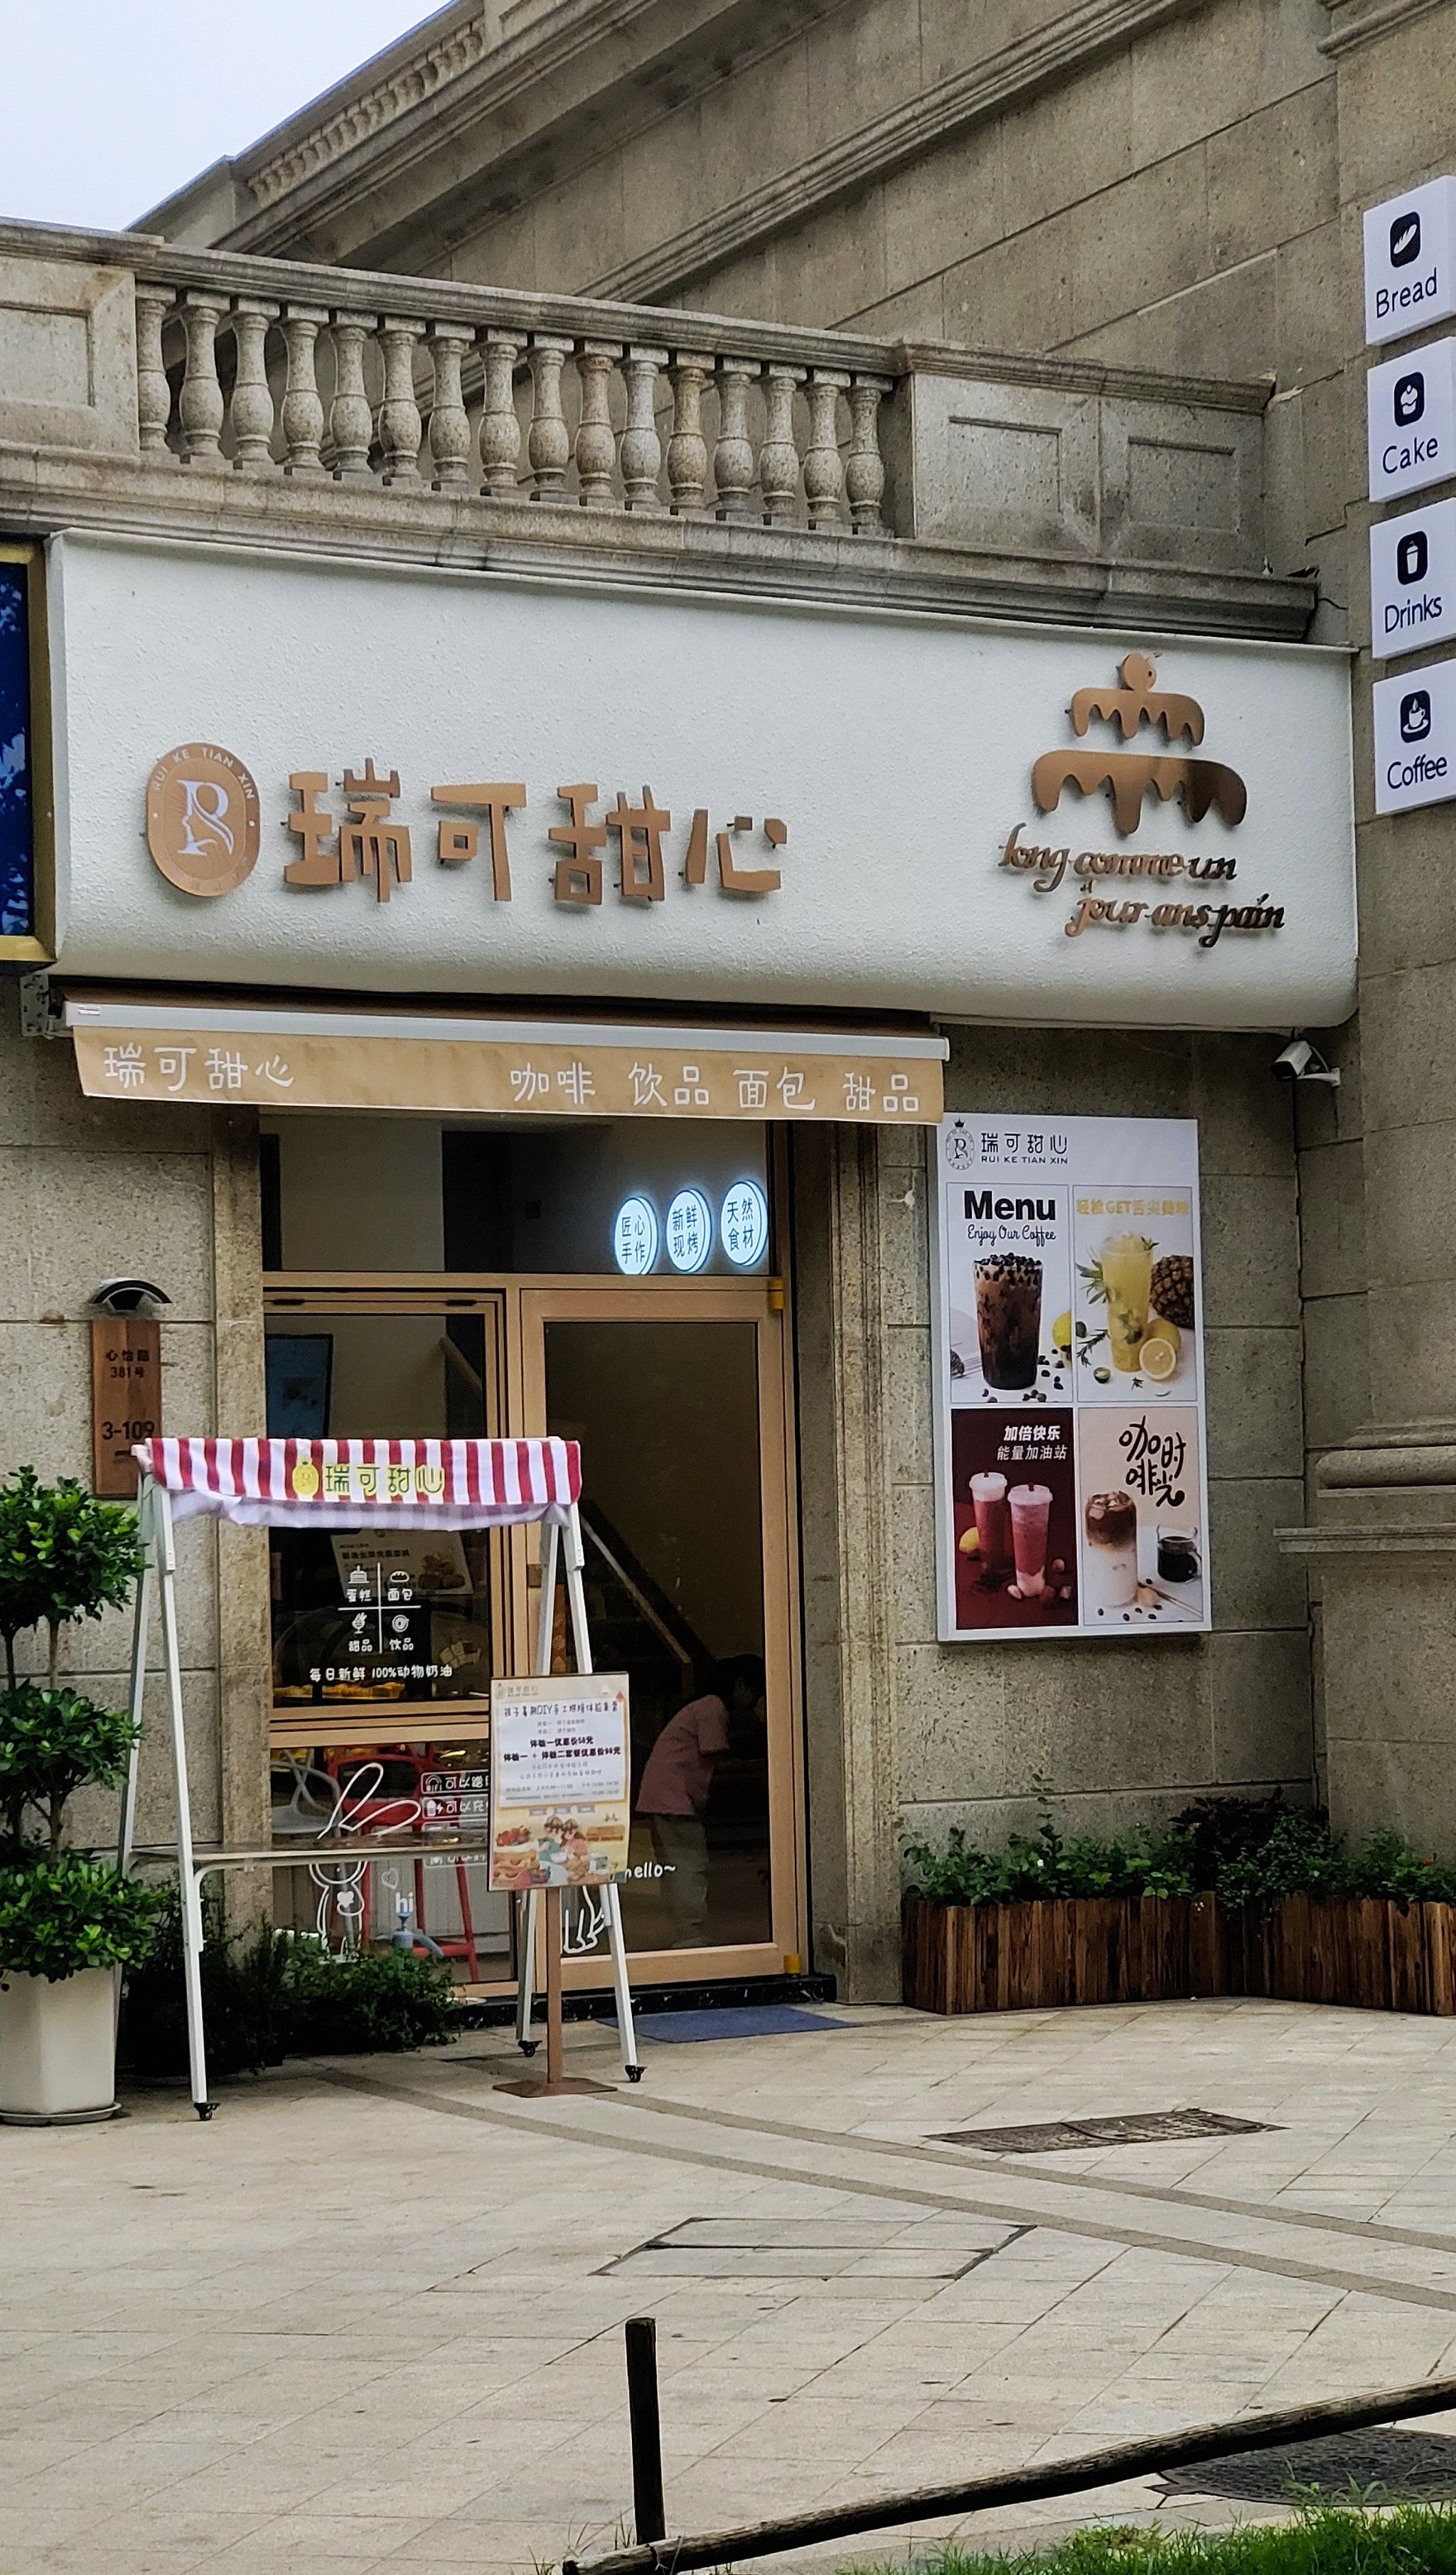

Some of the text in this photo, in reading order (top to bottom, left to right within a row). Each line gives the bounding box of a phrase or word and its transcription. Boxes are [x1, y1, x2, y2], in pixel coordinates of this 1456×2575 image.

[1376, 267, 1437, 318] Bread
[1383, 437, 1438, 474] Cake
[1385, 594, 1442, 633] Drinks
[152, 747, 255, 799] RUI KE TIAN XIN
[1387, 754, 1447, 789] Coffee
[284, 758, 787, 905] 瑞可甜心
[997, 822, 1238, 893] long comme un
[1065, 880, 1149, 938] jour
[1199, 893, 1285, 948] pain
[104, 1042, 920, 1113] 瑞可甜心 咖啡 饮品 面包 甜品
[981, 1133, 1067, 1154] 瑞可甜心
[672, 1204, 697, 1231] 新鲜
[727, 1197, 754, 1224] 天然
[963, 1190, 1056, 1221] Menu
[621, 1214, 646, 1238] 匠心
[728, 1224, 754, 1252] 食材
[968, 1224, 1056, 1247] Enjoy Our Coffee
[621, 1241, 646, 1264] 手作
[673, 1231, 698, 1258] 现烤
[102, 1421, 155, 1440] 3-109
[1003, 1425, 1061, 1442] 加倍快乐
[997, 1444, 1068, 1461] 能量加油站
[326, 1465, 443, 1494] 瑞可甜心
[346, 1588, 372, 1602] 蛋糕
[387, 1588, 412, 1602] 面包
[348, 1638, 373, 1652] 甜品
[390, 1637, 414, 1651] 饮品
[310, 1664, 453, 1682] 每日新鲜 100%动物奶油
[446, 1800, 488, 1814] 可以充
[395, 1892, 414, 1913] hi
